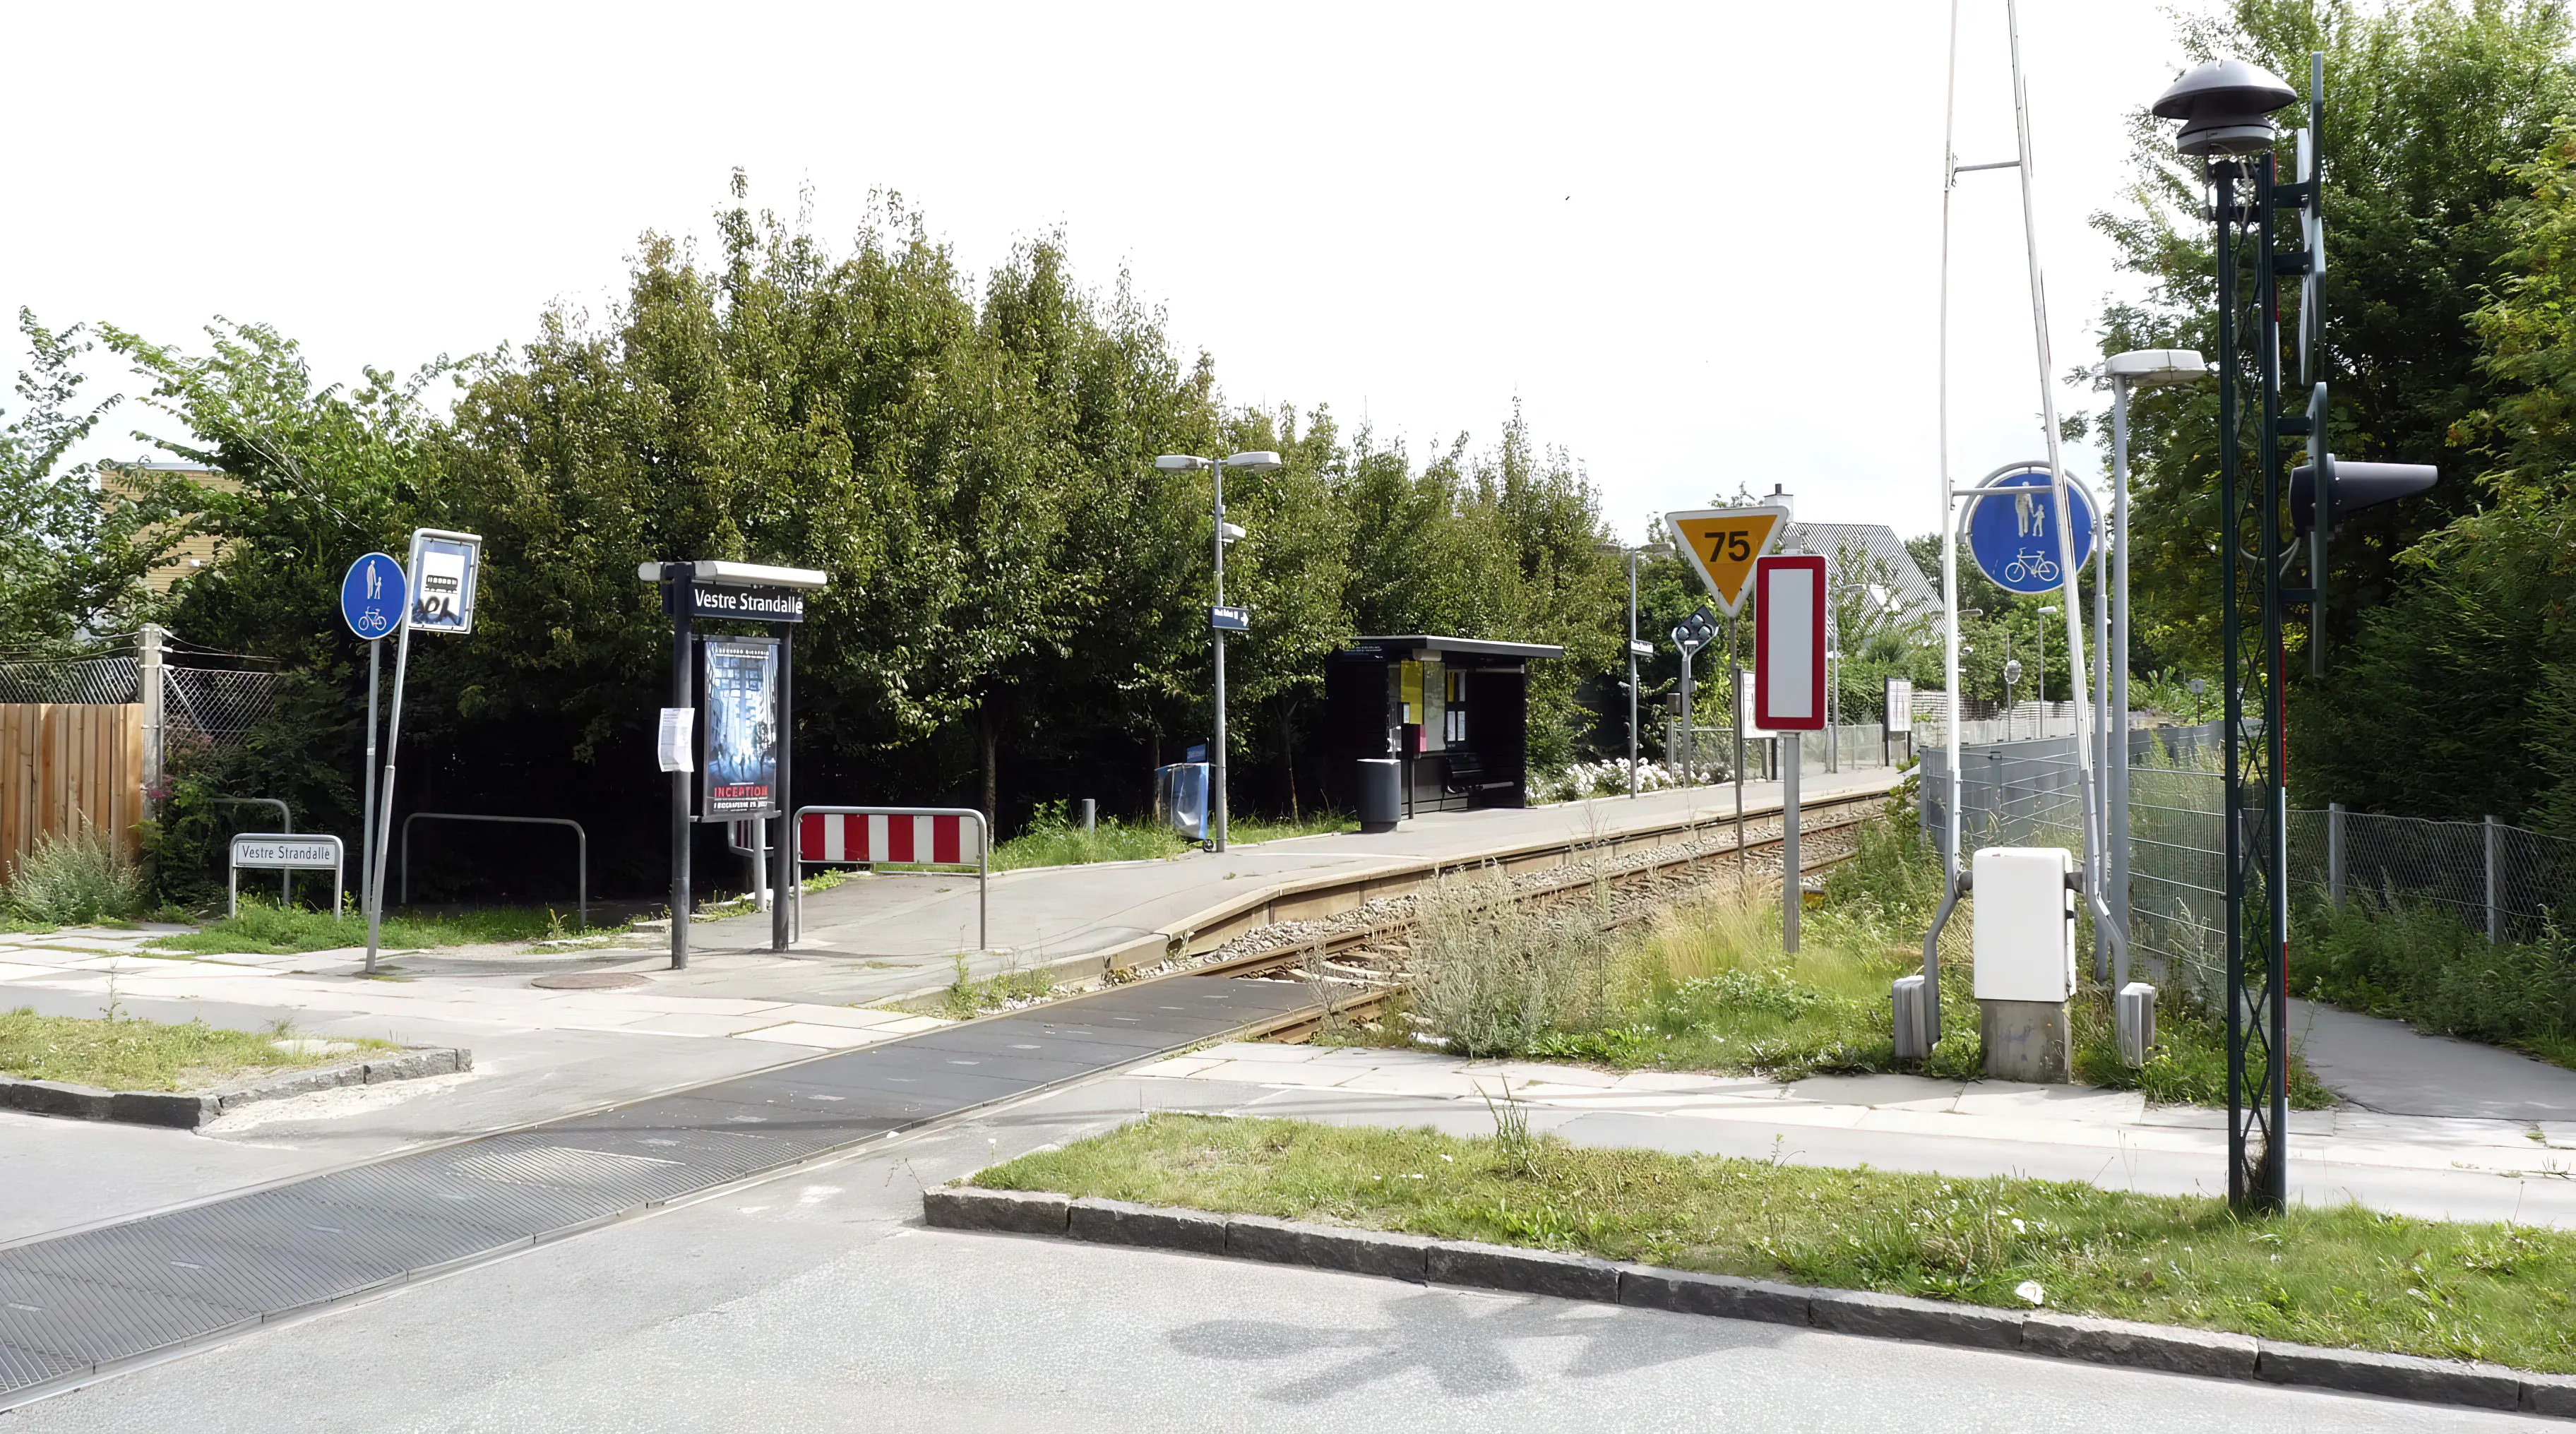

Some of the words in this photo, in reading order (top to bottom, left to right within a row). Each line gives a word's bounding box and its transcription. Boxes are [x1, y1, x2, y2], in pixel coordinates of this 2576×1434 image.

[1705, 531, 1751, 562] 75
[694, 589, 737, 609] Vestre
[739, 593, 803, 614] Strandallé
[242, 845, 274, 859] Vestre
[278, 846, 330, 859] Strandallé
